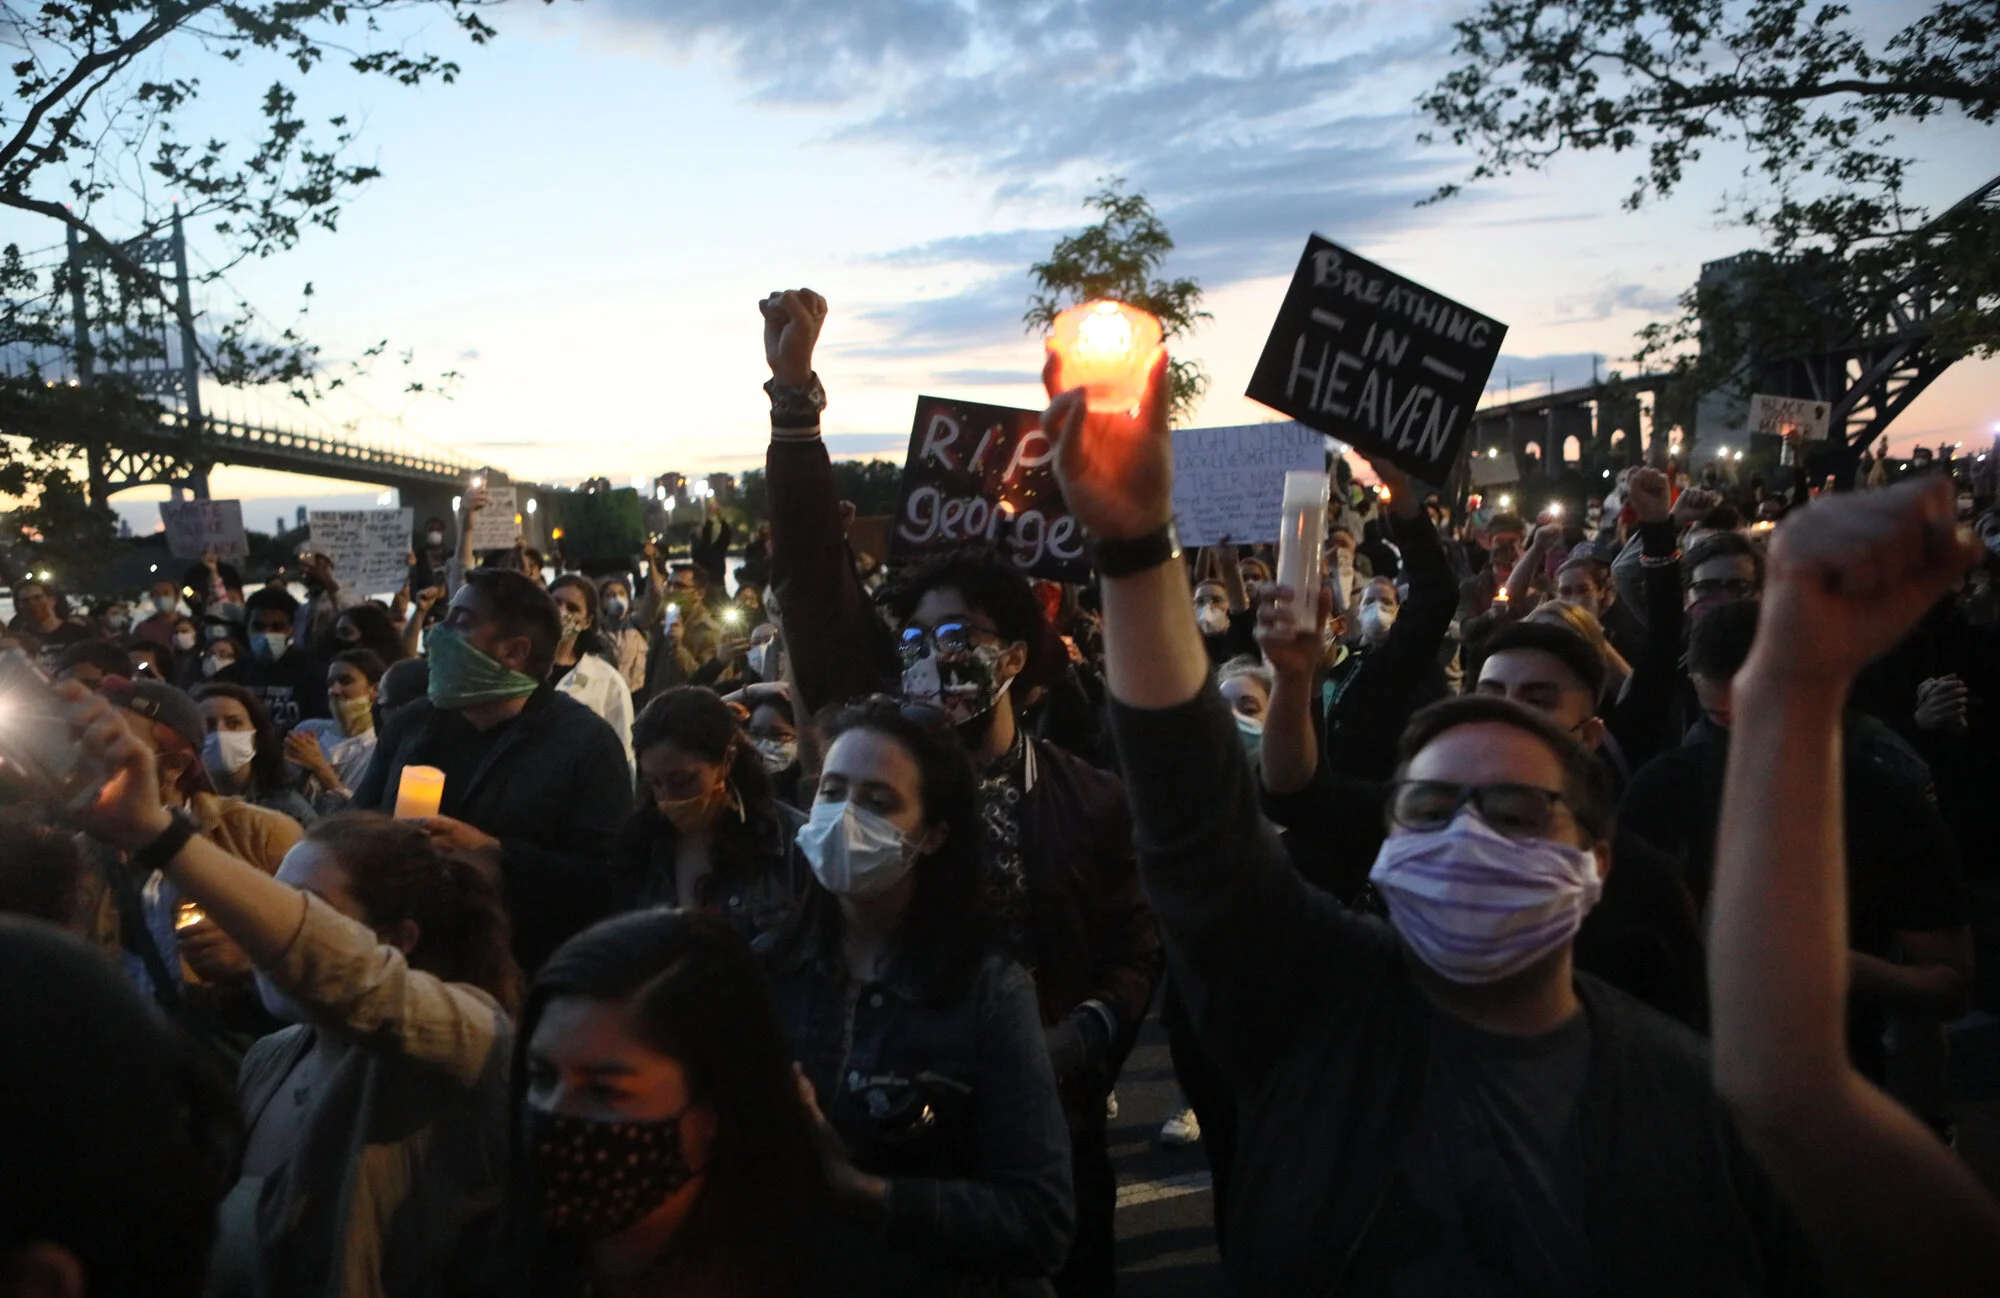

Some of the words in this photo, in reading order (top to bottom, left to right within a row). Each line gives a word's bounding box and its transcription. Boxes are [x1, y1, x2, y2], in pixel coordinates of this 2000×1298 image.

[1311, 249, 1491, 350] BREATHING
[1358, 321, 1410, 368] IN
[1284, 332, 1460, 463] HEAVEN
[899, 486, 1084, 568] george
